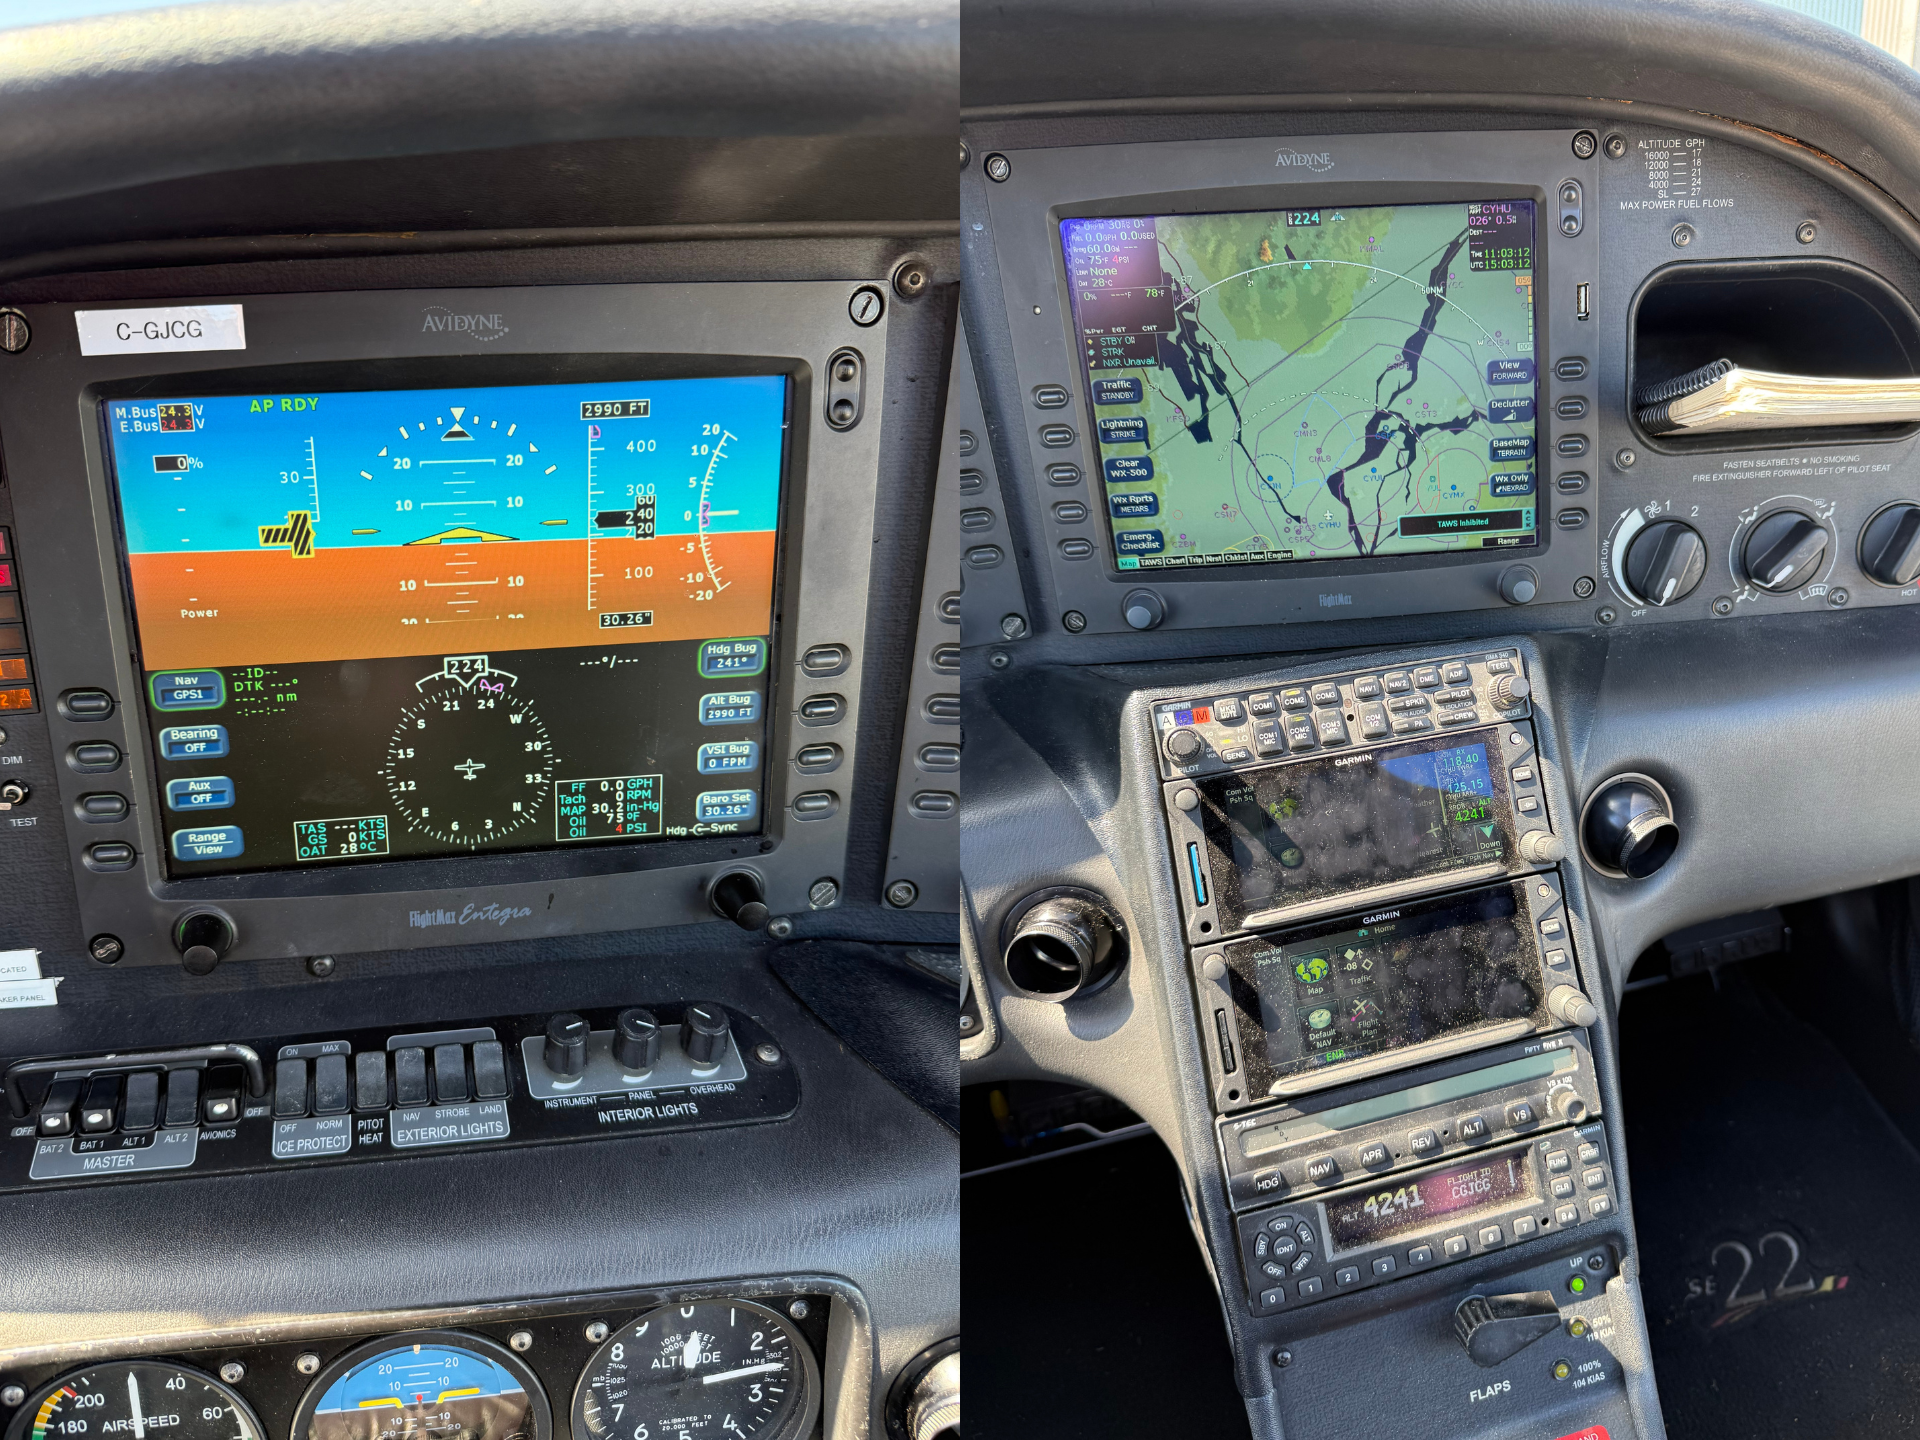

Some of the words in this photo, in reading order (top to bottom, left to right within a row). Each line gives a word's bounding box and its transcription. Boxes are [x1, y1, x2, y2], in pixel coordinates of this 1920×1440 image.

[1638, 139, 1681, 149] ALTITUDE
[1686, 139, 1705, 147] GPH
[1275, 153, 1330, 166] AVIDYNE
[1645, 151, 1669, 159] 16000
[1649, 171, 1669, 179] 8000
[1483, 204, 1511, 213] CYHU
[1621, 202, 1639, 210] MAX
[1643, 201, 1675, 209] POWER
[1678, 200, 1700, 208] FUEL
[1703, 199, 1733, 207] FLOWS
[1294, 213, 1319, 224] 224
[1485, 249, 1530, 258] 11:03:12
[1485, 259, 1530, 269] 15:03:12
[1090, 266, 1117, 275] None
[422, 313, 503, 332] AVIDYNE
[116, 320, 202, 340] C-GJCG
[1493, 372, 1527, 380] FORWARD
[1102, 381, 1131, 389] Traffic
[1102, 392, 1134, 400] STANDBY
[250, 399, 274, 413] AP
[282, 397, 319, 411] RDY
[1492, 399, 1529, 408] Declutter
[116, 407, 156, 419] M.Bus
[585, 404, 621, 416] 2990
[630, 402, 646, 414] FT
[121, 420, 158, 432] E.Bus
[1101, 419, 1143, 428] Lightning
[627, 440, 656, 452] 400
[1493, 439, 1529, 447] BaseMap
[1498, 449, 1526, 457] TERRAIN
[1723, 460, 1754, 469] FASTEN
[1756, 458, 1799, 468] SEATBELTS
[1810, 456, 1822, 464] NO
[1824, 455, 1860, 463] SMOKING
[1111, 469, 1147, 478] WX-500
[1712, 470, 1771, 481] EXTINGUISHER
[1773, 468, 1812, 477] FORWARD
[1814, 467, 1832, 475] LEFT
[1847, 465, 1866, 473] PILOT
[1869, 464, 1891, 472] SEAT
[1511, 474, 1528, 482] Ovly
[1130, 494, 1153, 503] Rprts
[1460, 518, 1488, 526] Inhibited
[1124, 533, 1155, 542] Emerg.
[1122, 542, 1160, 550] Checklist
[1140, 558, 1162, 566] TAWS
[1602, 539, 1610, 578] AIRFLOW
[625, 567, 653, 578] 100
[180, 608, 219, 619] Power
[1632, 609, 1646, 617] OFF
[603, 614, 650, 625] 30.26"
[708, 646, 730, 655] Hdg
[735, 644, 756, 653] Bug
[450, 659, 483, 673] 224
[175, 676, 198, 685] Nav
[234, 681, 264, 691] DTK
[1359, 684, 1376, 693] NAV1
[174, 690, 203, 699] GPS1
[709, 696, 725, 704] Alt
[729, 695, 750, 704] Bug
[1285, 697, 1304, 705] COM2
[1405, 698, 1424, 707] SPKR
[1162, 702, 1191, 712] GARMIN
[1253, 702, 1272, 711] COM1
[708, 710, 734, 718] 2990
[171, 729, 218, 740] Bearing
[185, 743, 206, 752] OFF
[707, 746, 725, 754] VSI
[729, 745, 749, 754] Bug
[1227, 751, 1246, 760] SENS
[1335, 754, 1372, 766] GARMIN
[723, 758, 746, 766] FPM
[1444, 754, 1479, 768] 118.40
[189, 781, 210, 790] Aux
[600, 781, 624, 791] 0.0
[1448, 779, 1483, 793] 125.15
[191, 794, 212, 803] OFF
[559, 794, 585, 804] Tach
[703, 795, 729, 803] Baro
[732, 794, 751, 802] Set
[561, 806, 586, 815] MAP
[592, 803, 623, 814] 30.2
[627, 801, 659, 812] in-Hg
[705, 805, 747, 815] 30.26"
[1455, 807, 1485, 822] 4241
[10, 817, 38, 827] TEST
[359, 819, 385, 830] KTS
[570, 817, 586, 826] Oil
[627, 824, 647, 833] PSI
[189, 832, 226, 842] Range
[360, 830, 385, 840] KTS
[194, 845, 223, 854] View
[1480, 841, 1500, 849] Down
[300, 846, 327, 857] OAT
[410, 909, 456, 928] FlightMax
[458, 903, 532, 926] Entegra
[1363, 911, 1400, 924] GARMIN
[1375, 924, 1395, 934] Home
[1350, 975, 1372, 985] Traffic
[1308, 987, 1323, 995] Map
[1358, 1018, 1378, 1029] Flight
[1309, 1029, 1336, 1041] Default
[1317, 1039, 1332, 1048] NAV
[1326, 1050, 1345, 1062] ENR
[690, 1083, 735, 1095] OVERHEAD
[629, 1091, 656, 1101] PANEL
[545, 1096, 597, 1108] INSTRUMENT
[247, 1108, 263, 1116] OFF
[435, 1107, 470, 1118] STROBE
[479, 1105, 502, 1114] LAND
[598, 1107, 654, 1123] INTERIOR
[657, 1103, 698, 1116] LIGHTS
[403, 1112, 420, 1121] NAV
[280, 1123, 297, 1133] OFF
[317, 1120, 342, 1130] NORM
[358, 1119, 384, 1130] PITOT
[1463, 1122, 1480, 1135] ALT
[200, 1130, 236, 1140] AVIONICS
[398, 1126, 458, 1142] EXTERIOR
[462, 1121, 503, 1135] LIGHTS
[123, 1138, 138, 1146] ALT
[165, 1135, 180, 1143] ALT
[277, 1141, 294, 1152] ICE
[297, 1135, 347, 1150] PROTECT
[359, 1133, 383, 1144] HEAT
[40, 1146, 56, 1154] BAT
[80, 1141, 98, 1150] BAT
[1362, 1149, 1382, 1163] APR
[84, 1155, 134, 1169] MASTER
[1310, 1163, 1330, 1177] NAV
[1447, 1172, 1477, 1186] FLIGHT
[1257, 1178, 1278, 1191] HDG
[1364, 1185, 1424, 1217] 4241
[1276, 1244, 1294, 1254] IDNT
[1570, 1257, 1583, 1268] UP
[1712, 1231, 1816, 1309] 22
[1578, 1360, 1601, 1373] 100%
[1587, 1372, 1605, 1384] KIAS
[165, 1377, 186, 1390] 40
[1470, 1380, 1511, 1402] FLAPS
[75, 1394, 105, 1408] 200
[203, 1407, 223, 1420] 60
[58, 1420, 87, 1434] 180
